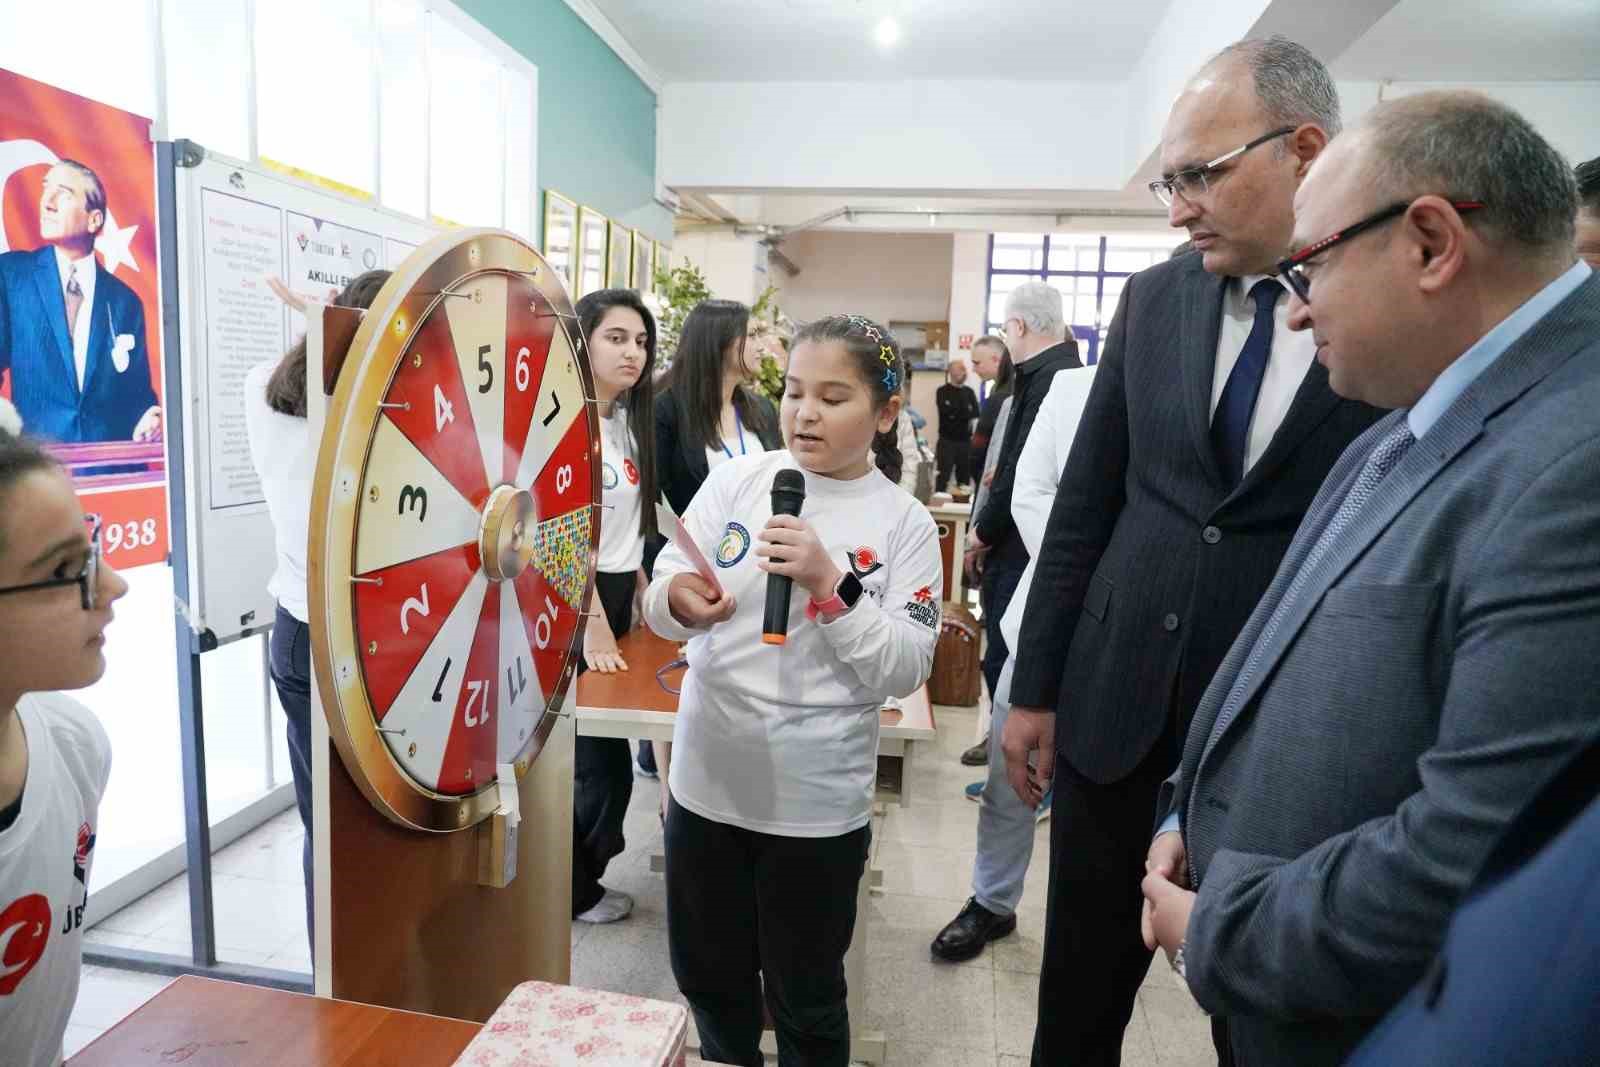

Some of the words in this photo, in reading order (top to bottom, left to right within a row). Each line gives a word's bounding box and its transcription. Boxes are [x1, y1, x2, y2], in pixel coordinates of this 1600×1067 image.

[307, 269, 339, 286] AKILLI
[477, 344, 494, 394] 5
[514, 346, 531, 392] 6
[433, 383, 455, 433] 4
[542, 389, 562, 428] 7
[556, 463, 573, 494] 8
[398, 484, 428, 523] 3
[400, 582, 430, 635] 2
[534, 595, 559, 650] 10
[431, 656, 452, 702] 1
[507, 655, 527, 707] 11
[463, 679, 491, 728] 12
